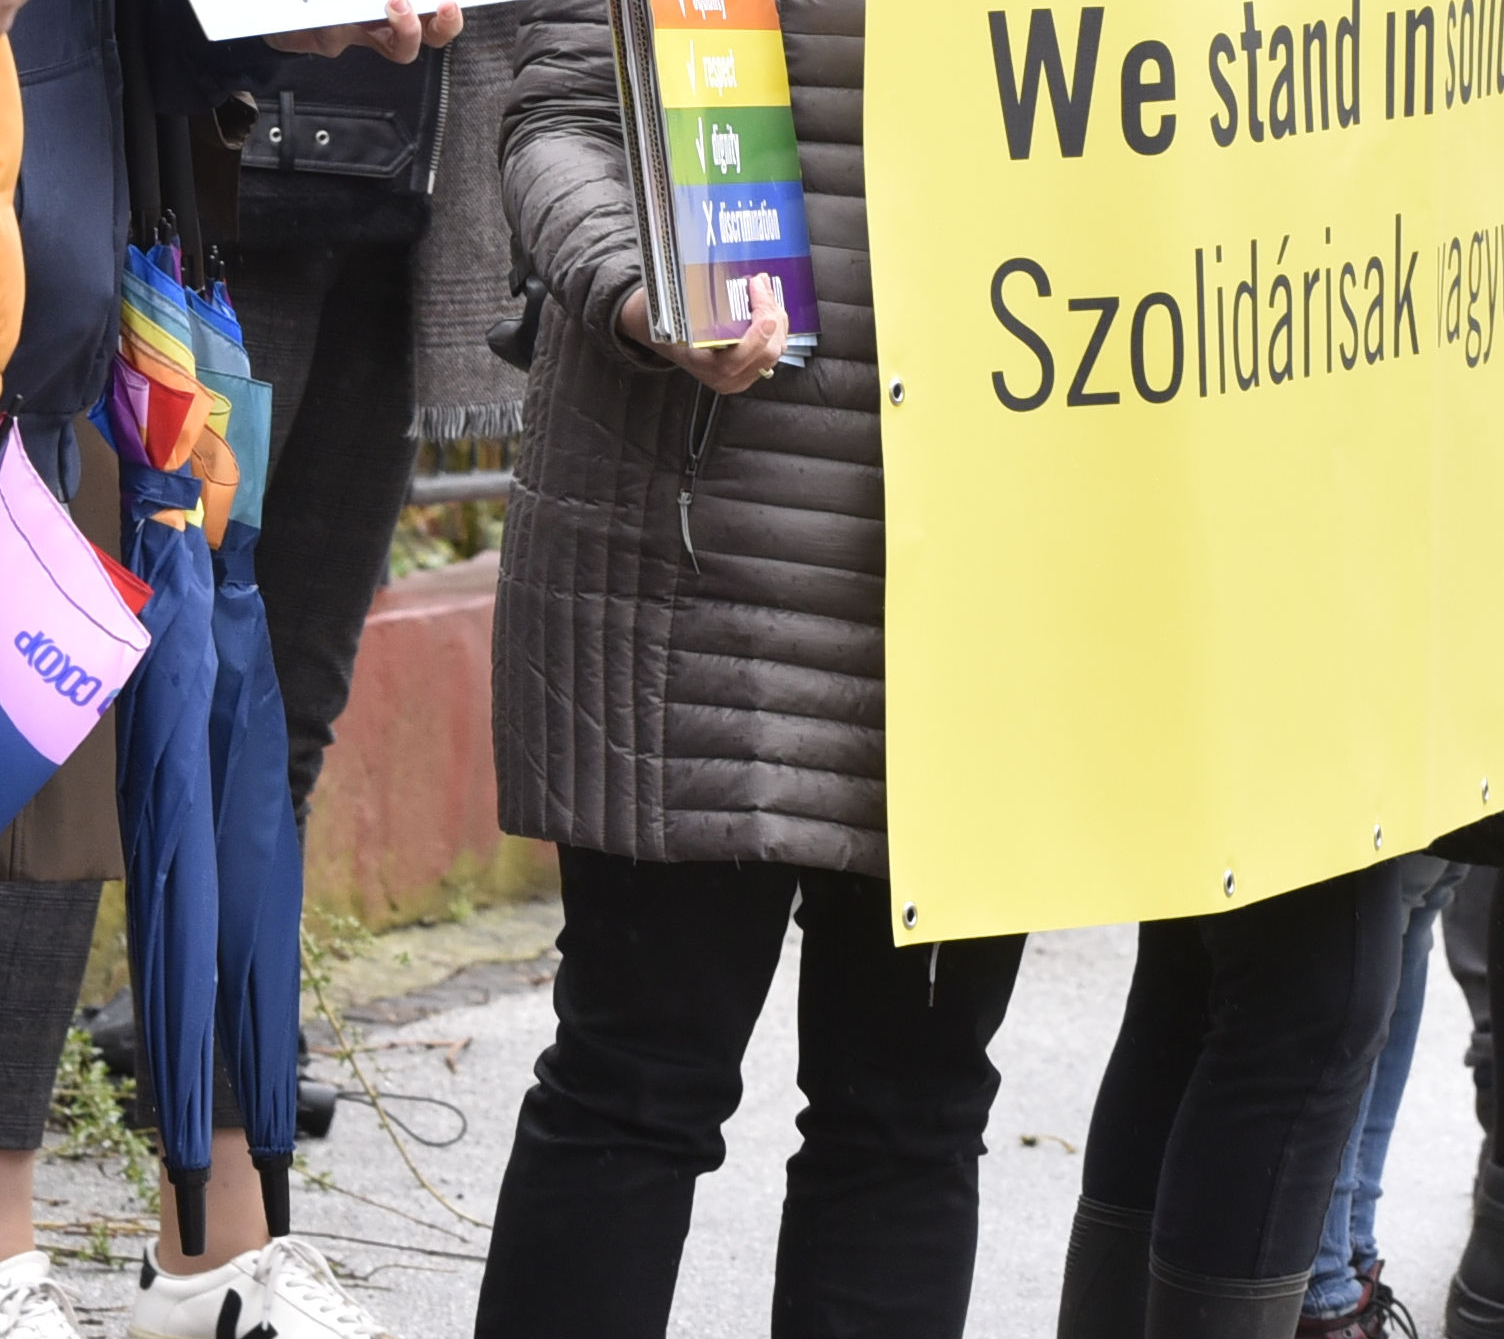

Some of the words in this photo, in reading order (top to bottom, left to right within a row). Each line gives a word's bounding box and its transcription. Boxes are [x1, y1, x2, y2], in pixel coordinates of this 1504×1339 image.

[702, 49, 738, 97] respect
[987, 6, 1178, 161] We
[711, 123, 741, 175] dignity
[718, 199, 782, 244] discrimination
[990, 213, 1420, 413] Szolidárisak
